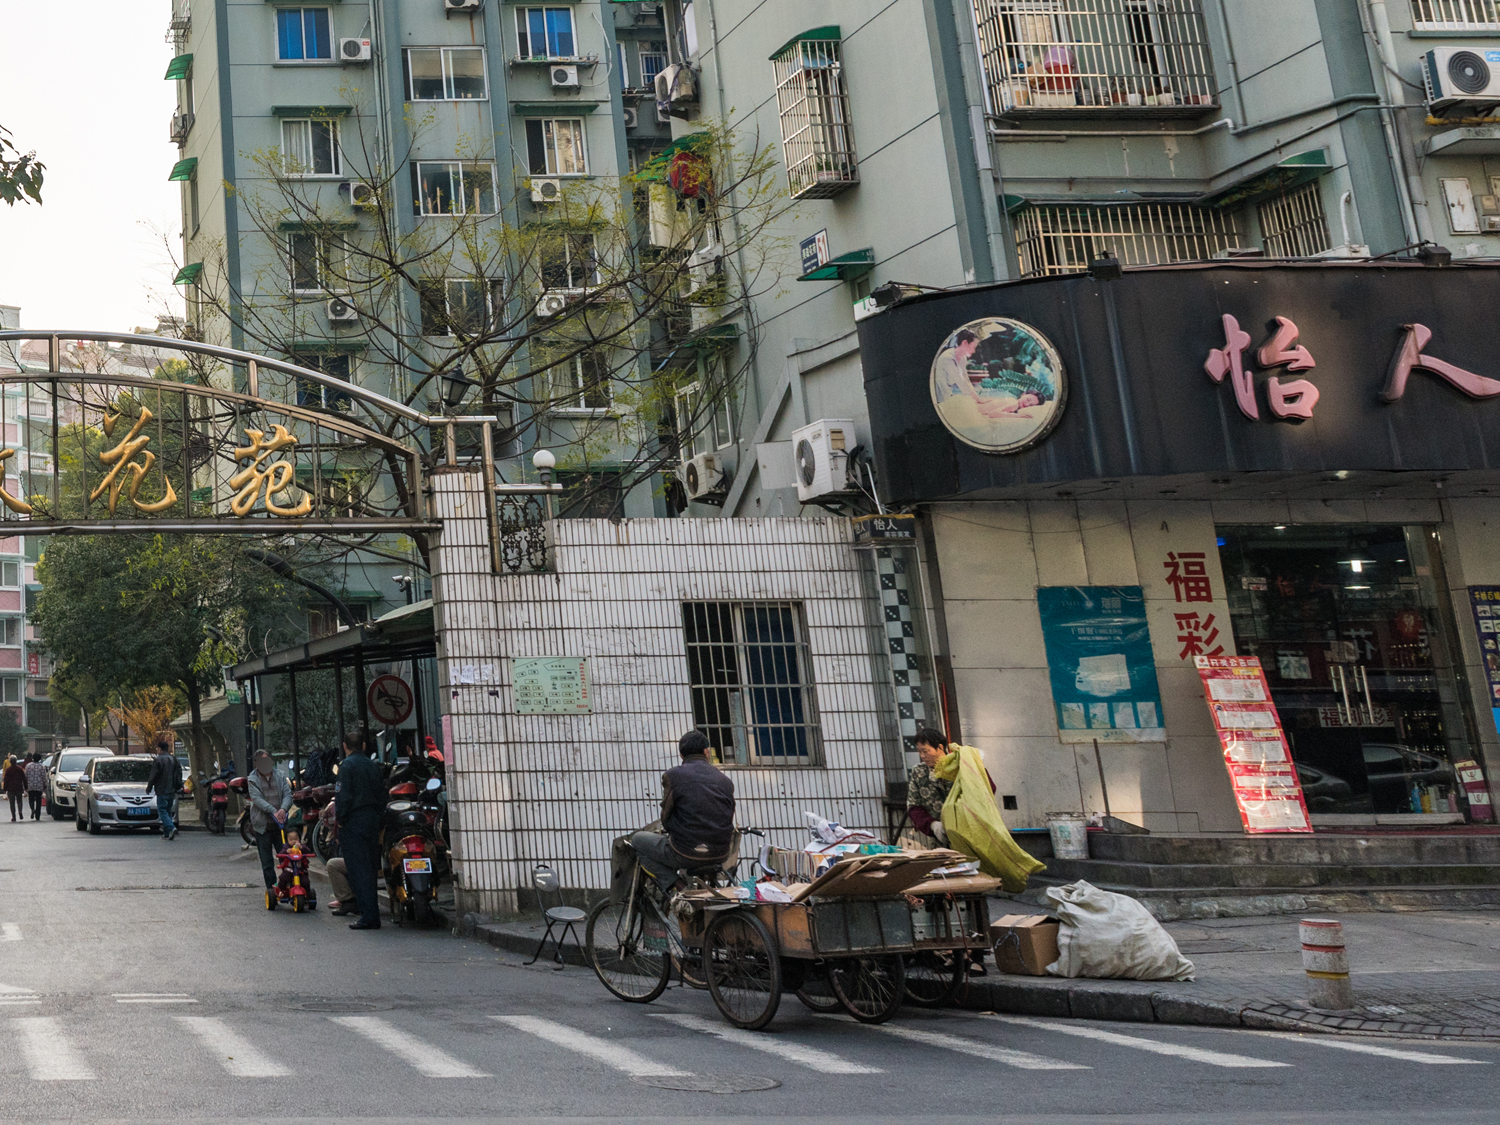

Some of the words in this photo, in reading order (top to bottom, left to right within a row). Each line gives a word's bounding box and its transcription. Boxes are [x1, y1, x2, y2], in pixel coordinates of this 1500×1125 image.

[817, 235, 829, 265] 51
[1204, 313, 1500, 422] 怡人
[873, 518, 898, 531] 怡人
[1163, 551, 1225, 661] 福彩
[1209, 658, 1248, 667] 开奖公告
